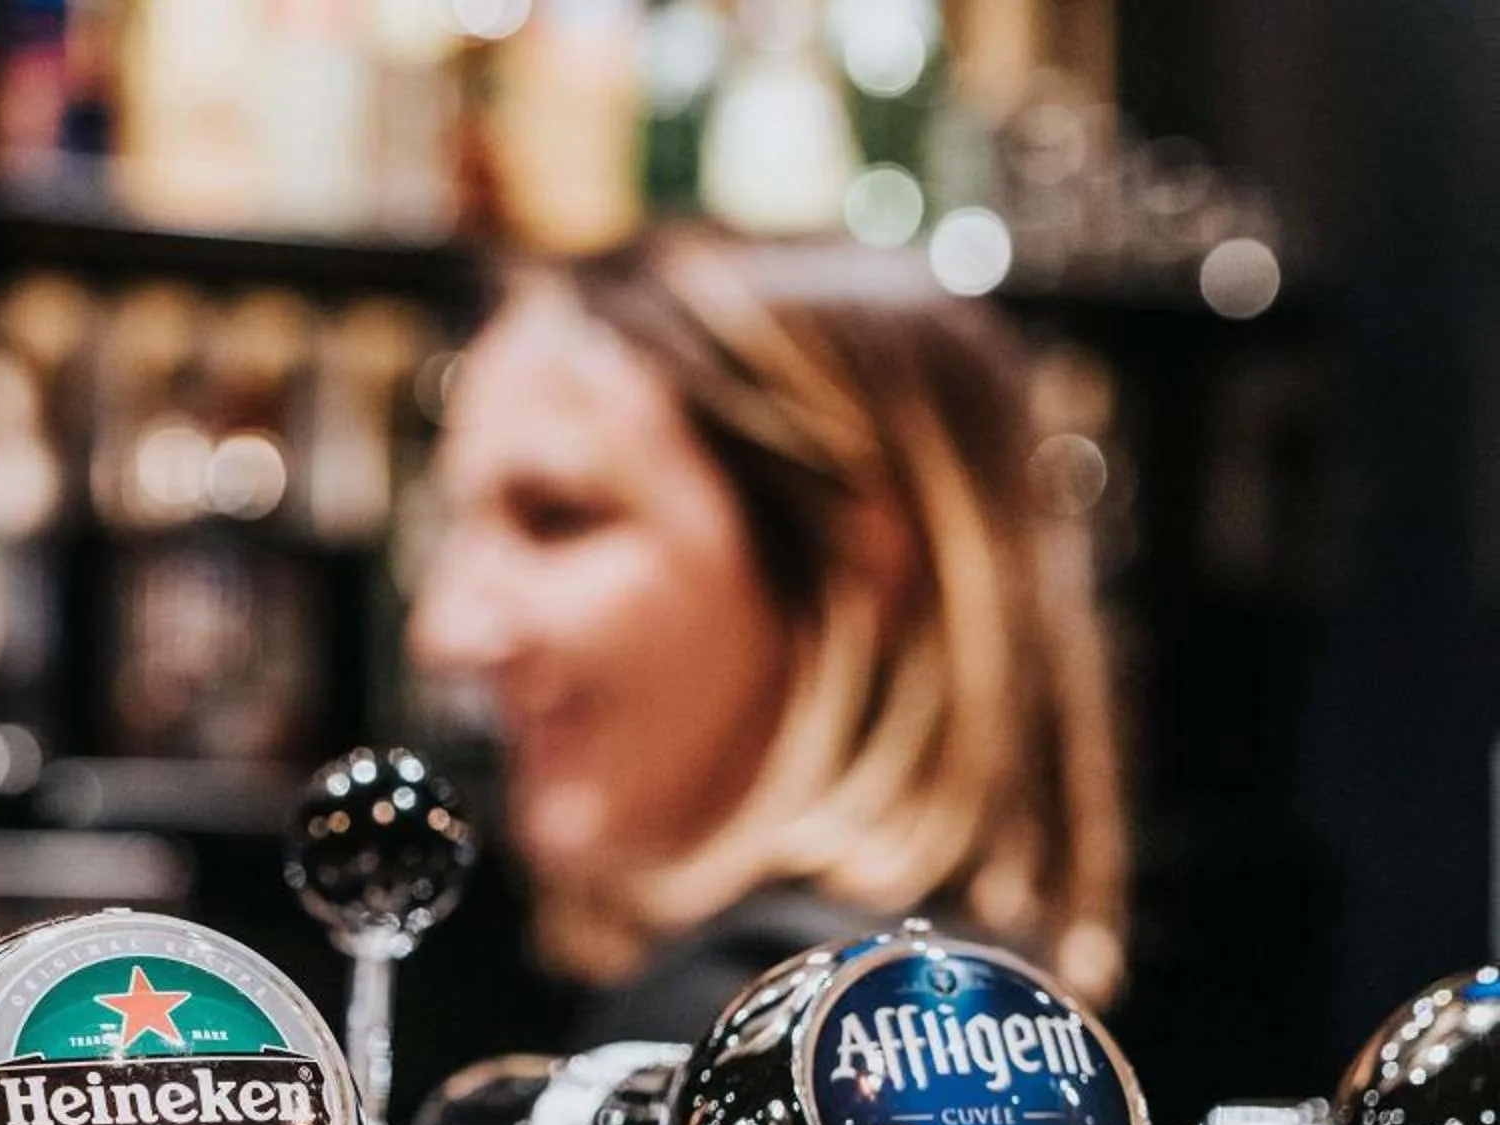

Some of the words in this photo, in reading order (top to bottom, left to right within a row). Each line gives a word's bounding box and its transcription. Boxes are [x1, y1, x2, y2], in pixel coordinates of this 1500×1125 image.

[11, 938, 143, 1006] ORIGINAL
[191, 1029, 229, 1041] MARK
[831, 1002, 1097, 1092] Affligem
